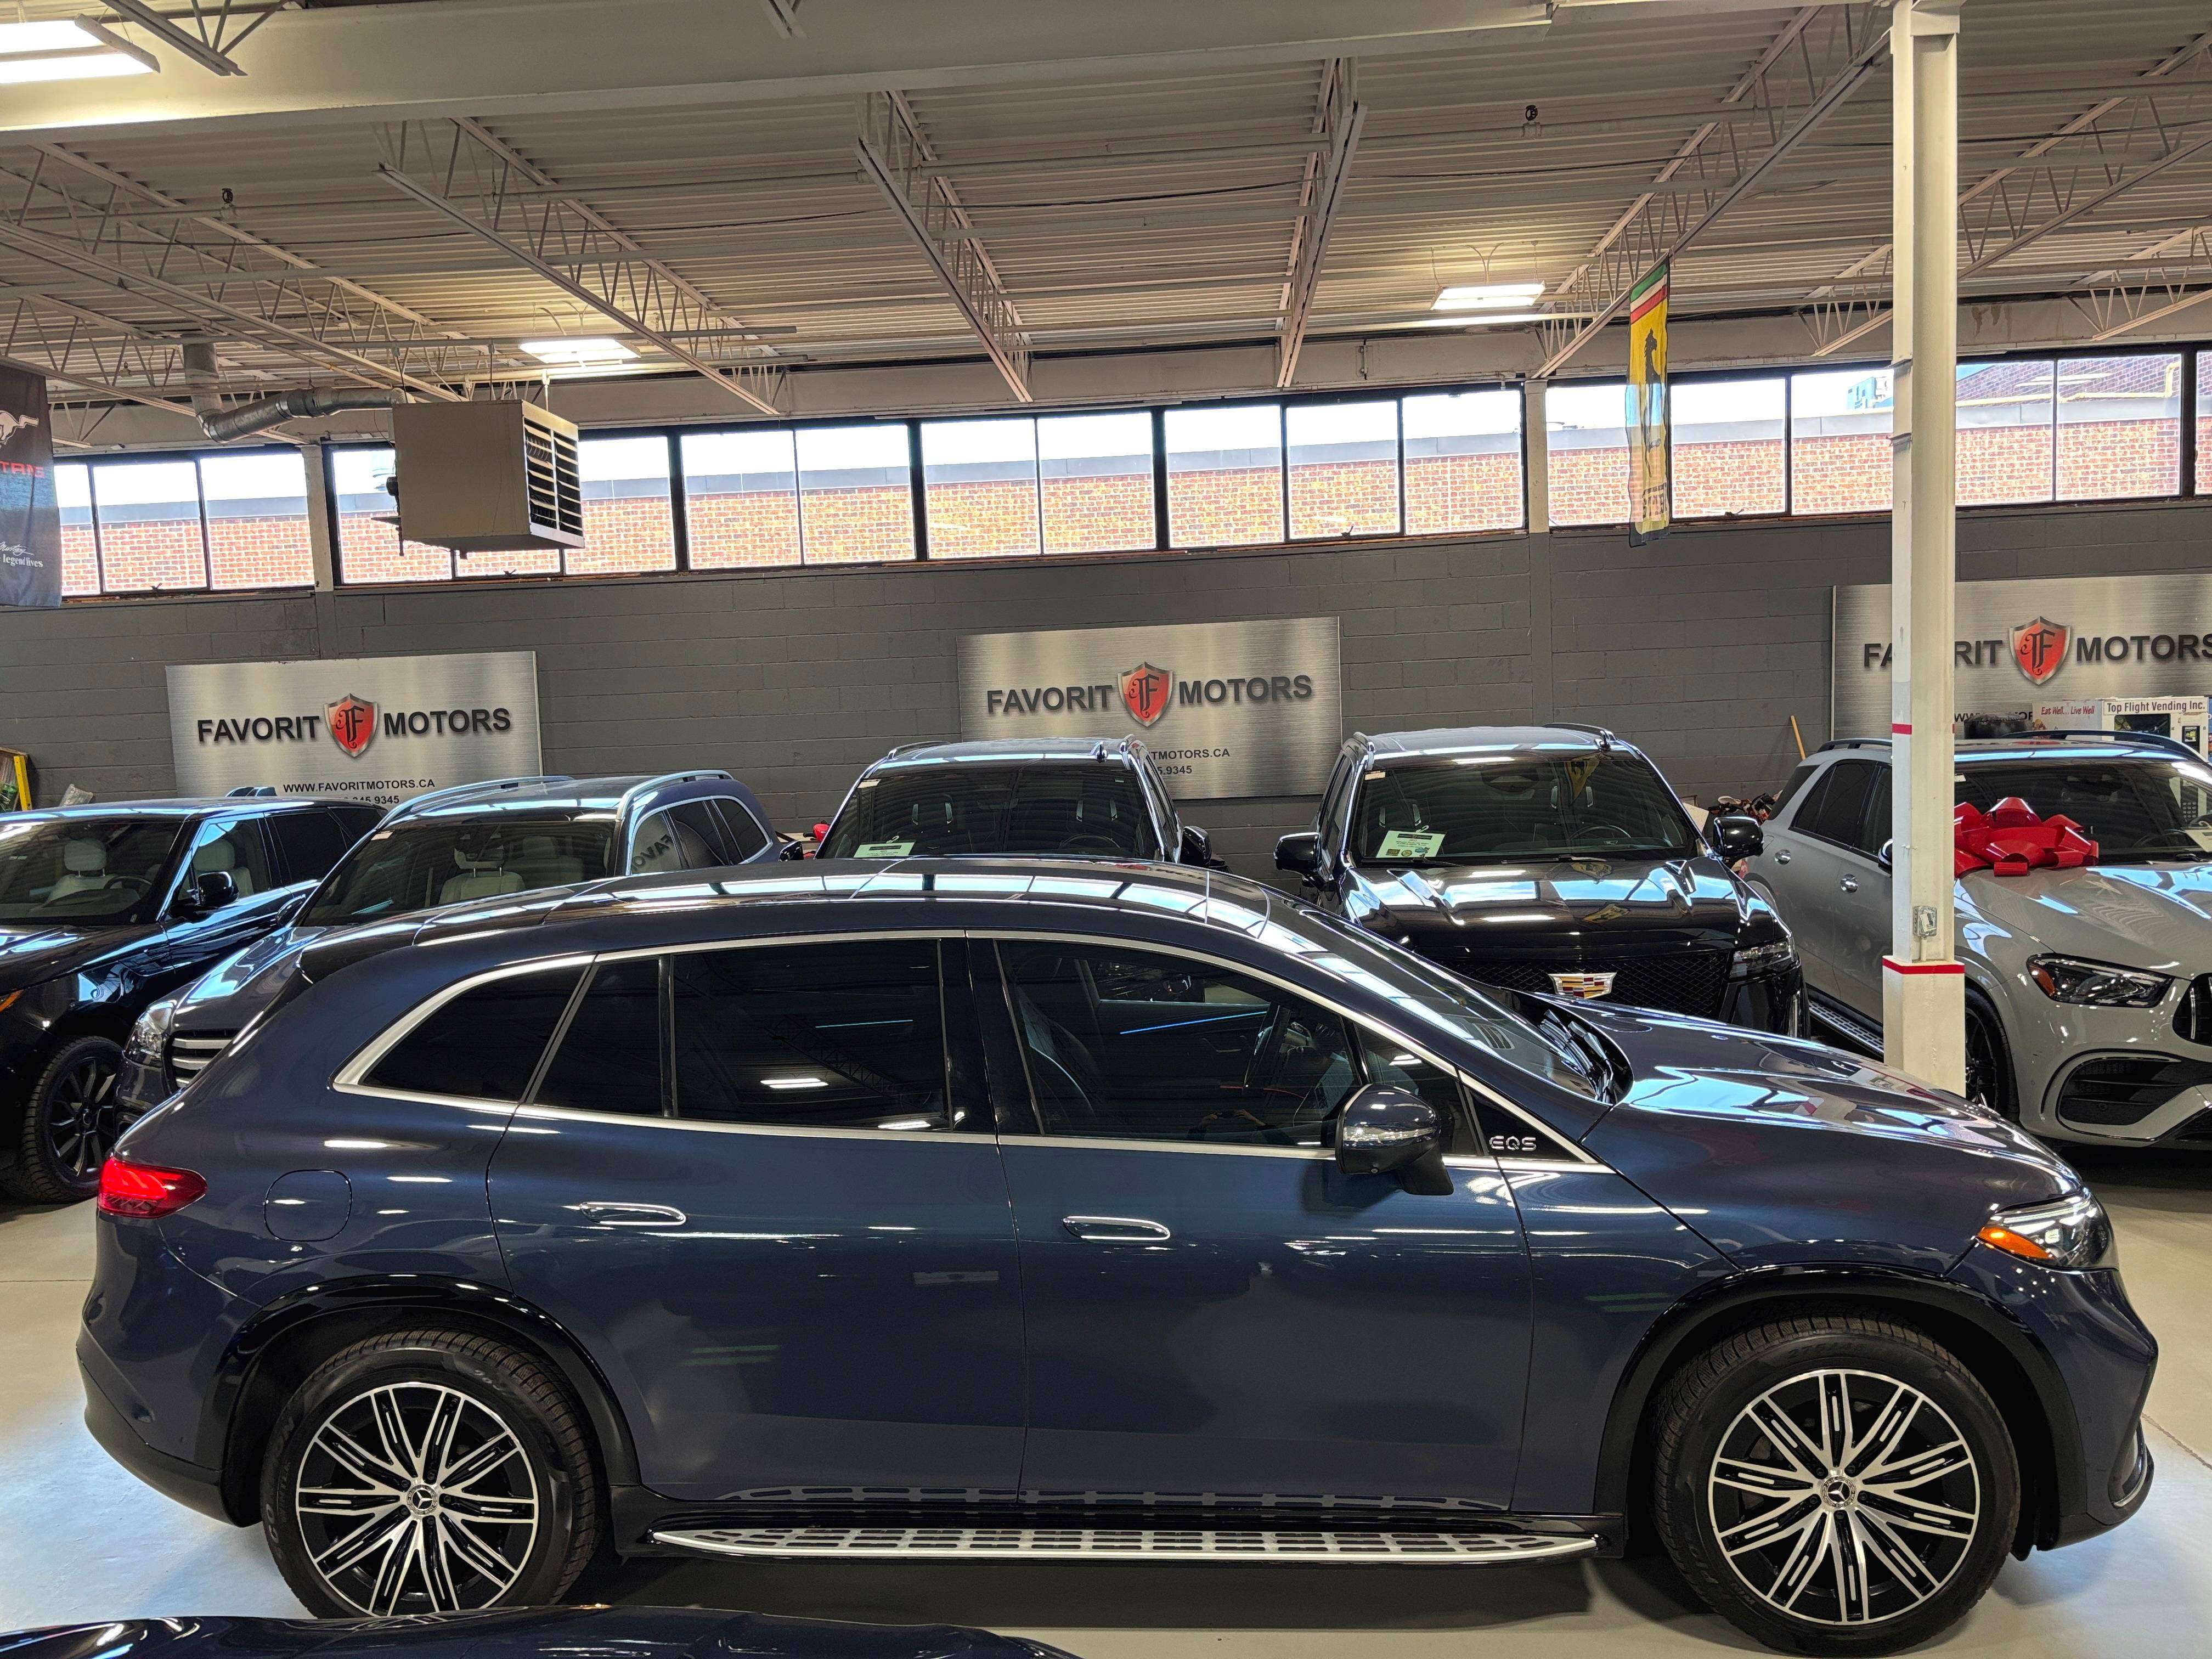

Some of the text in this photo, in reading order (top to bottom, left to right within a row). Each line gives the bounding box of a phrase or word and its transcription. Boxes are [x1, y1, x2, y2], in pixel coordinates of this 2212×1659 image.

[987, 685, 1113, 713] FAVORIT
[1179, 675, 1313, 704] MOTORS
[2041, 707, 2051, 715] Eat
[2070, 706, 2081, 714] Live
[2083, 706, 2095, 715] Well
[2107, 701, 2205, 714] Top Flight Vending Inc.
[198, 715, 320, 742] FAVORIT
[384, 708, 511, 736] MOTORS
[1149, 748, 1231, 760] TMOTORS.CA
[283, 779, 436, 793] WWW.FAVORITMOTORS.CA
[1489, 1135, 1537, 1151] EQS
